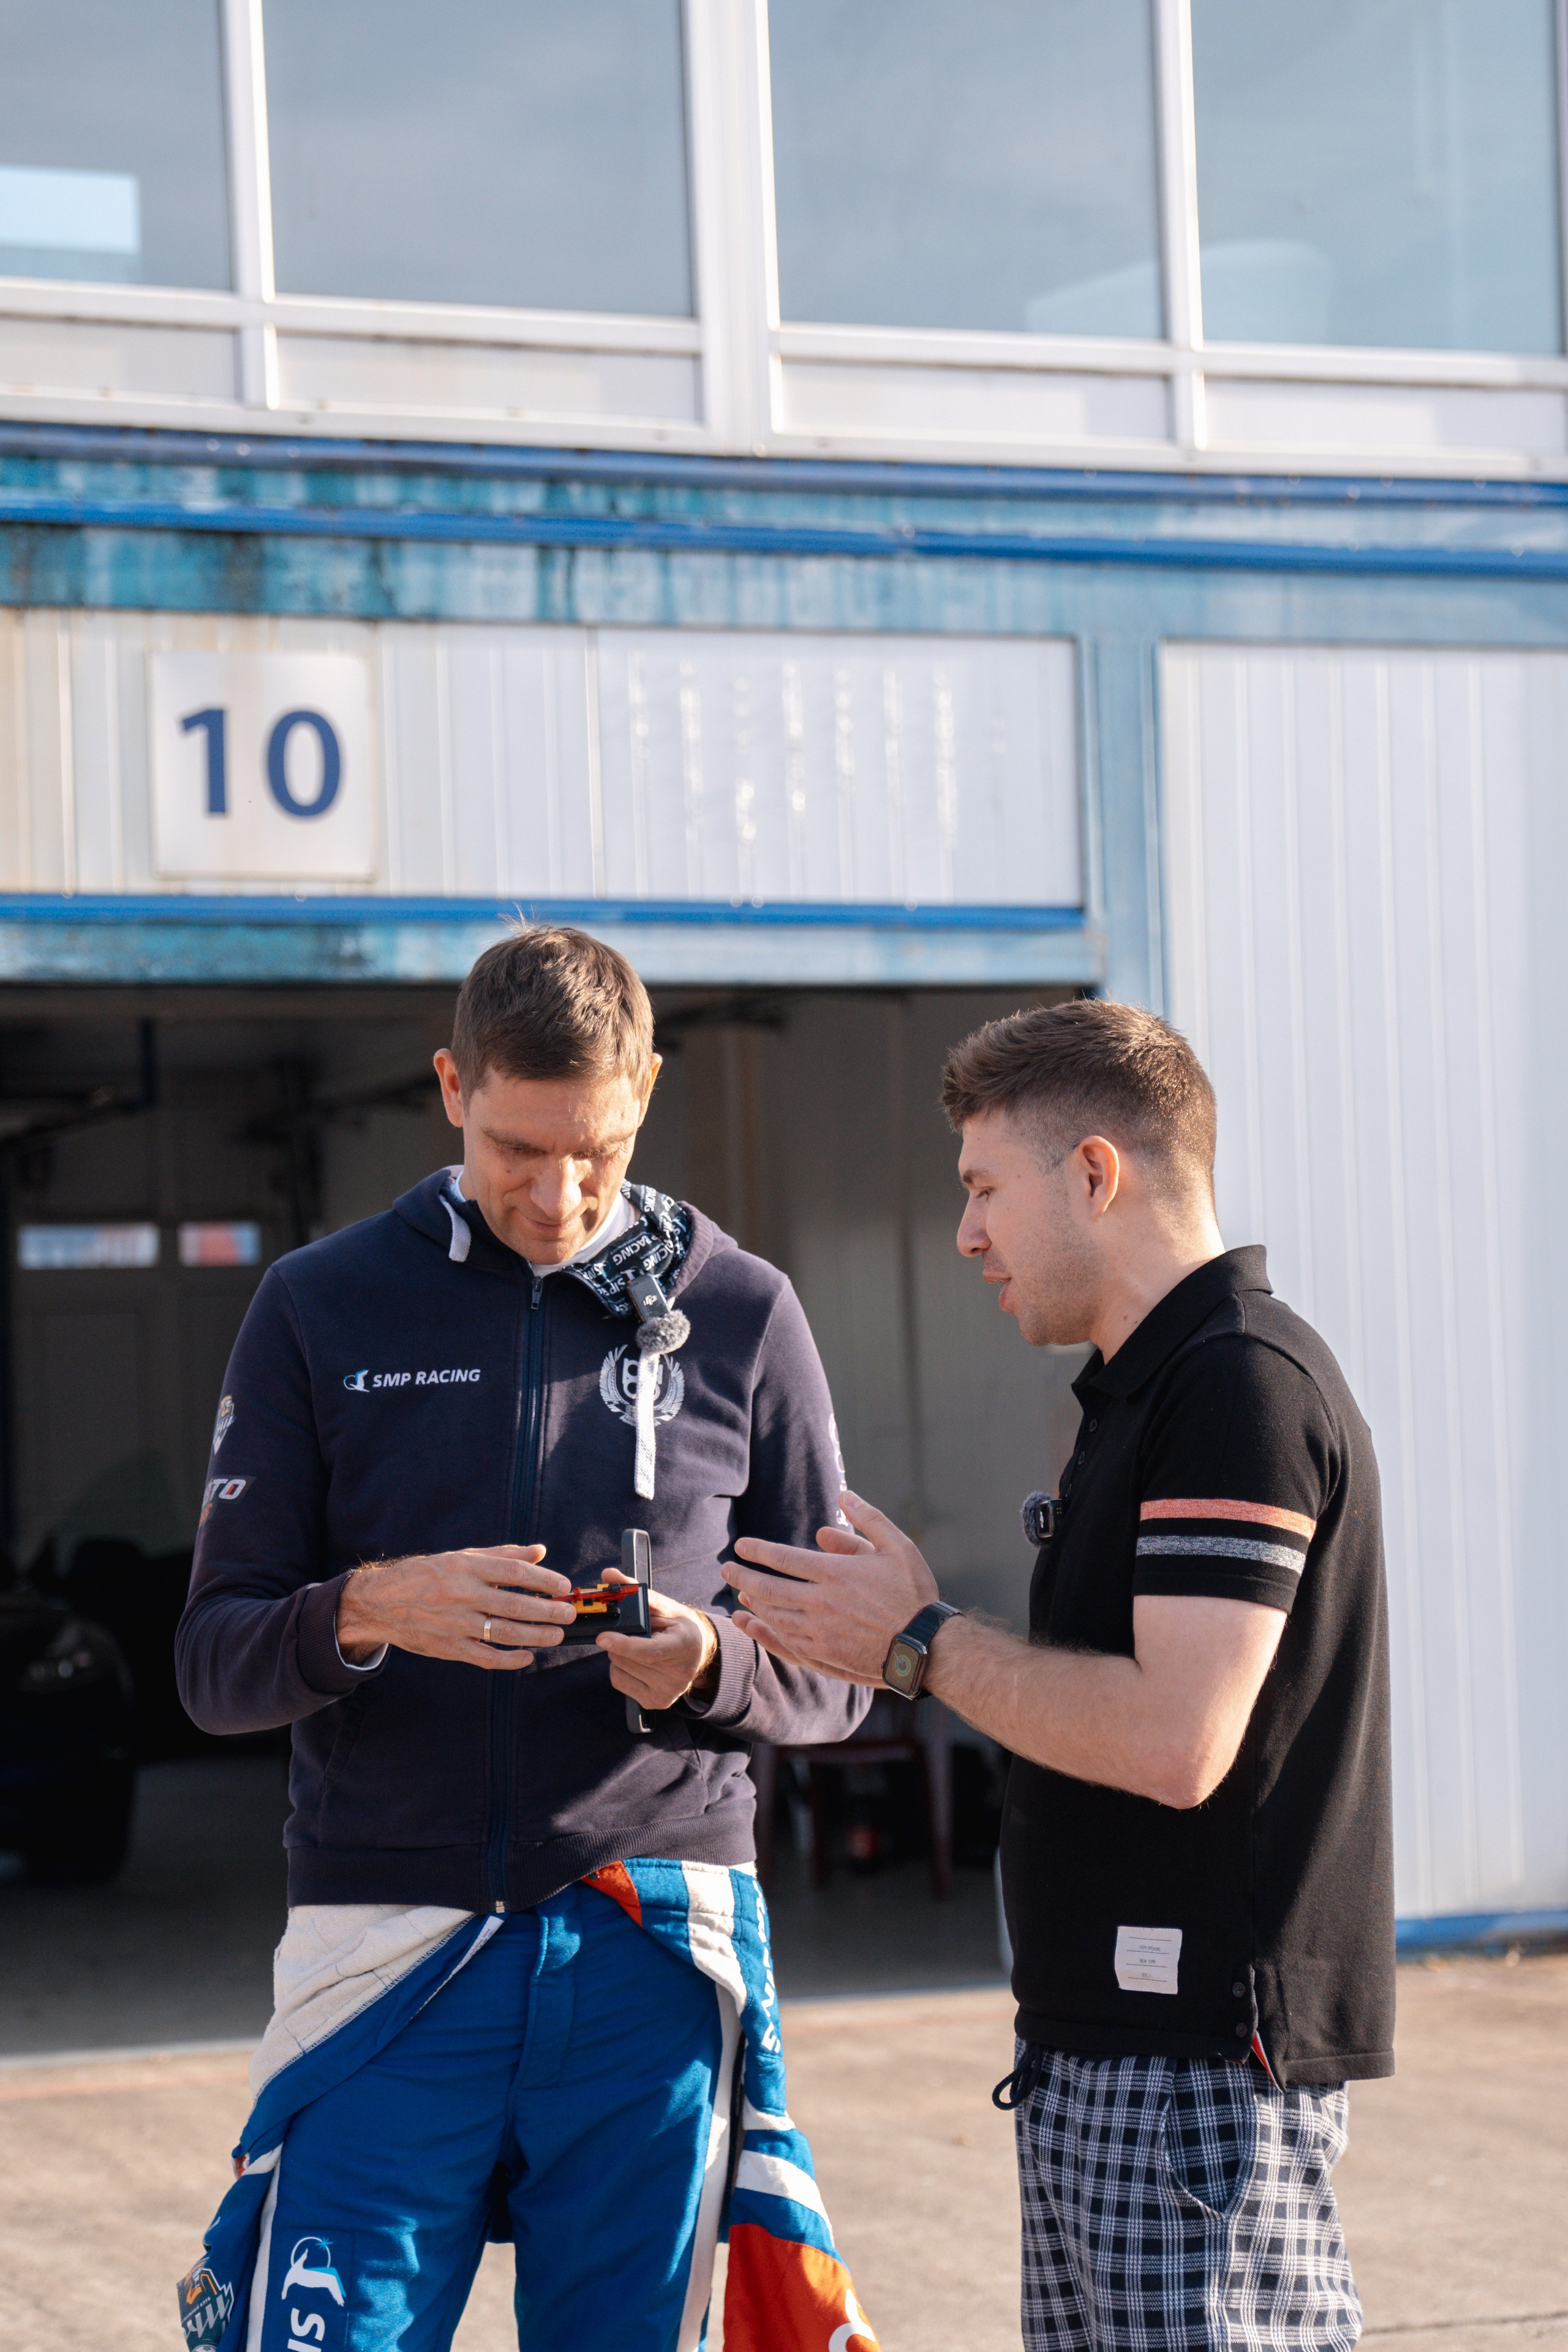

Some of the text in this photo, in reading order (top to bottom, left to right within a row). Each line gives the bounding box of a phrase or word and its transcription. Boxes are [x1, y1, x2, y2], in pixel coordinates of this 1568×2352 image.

[181, 706, 341, 819] 10
[372, 1369, 481, 1387] SMP RACING
